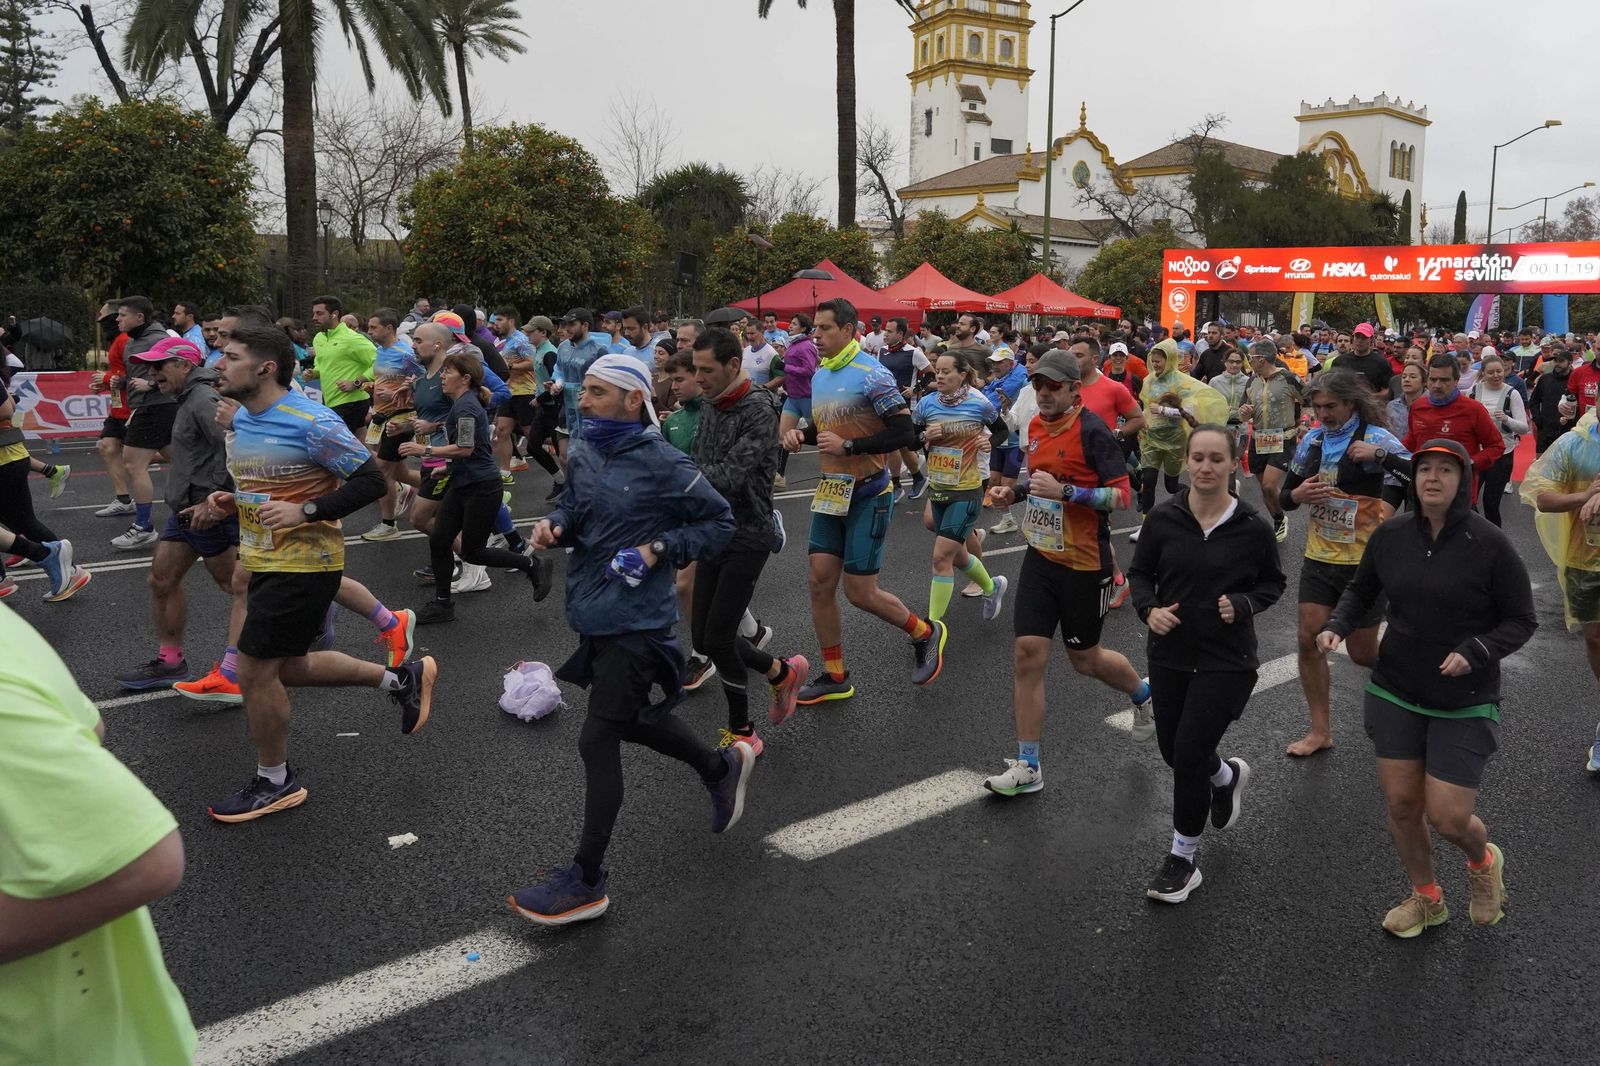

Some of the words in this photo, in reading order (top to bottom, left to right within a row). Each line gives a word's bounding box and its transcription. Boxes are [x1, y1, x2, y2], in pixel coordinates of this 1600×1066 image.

[1322, 262, 1367, 277] HOKA
[1440, 254, 1512, 270] maratón
[1244, 265, 1282, 275] Sprinter
[1454, 266, 1512, 281] sevilla
[929, 455, 955, 468] 17134
[819, 481, 846, 496] 17135
[1027, 508, 1055, 529] 19264
[1311, 504, 1347, 524] 22184
